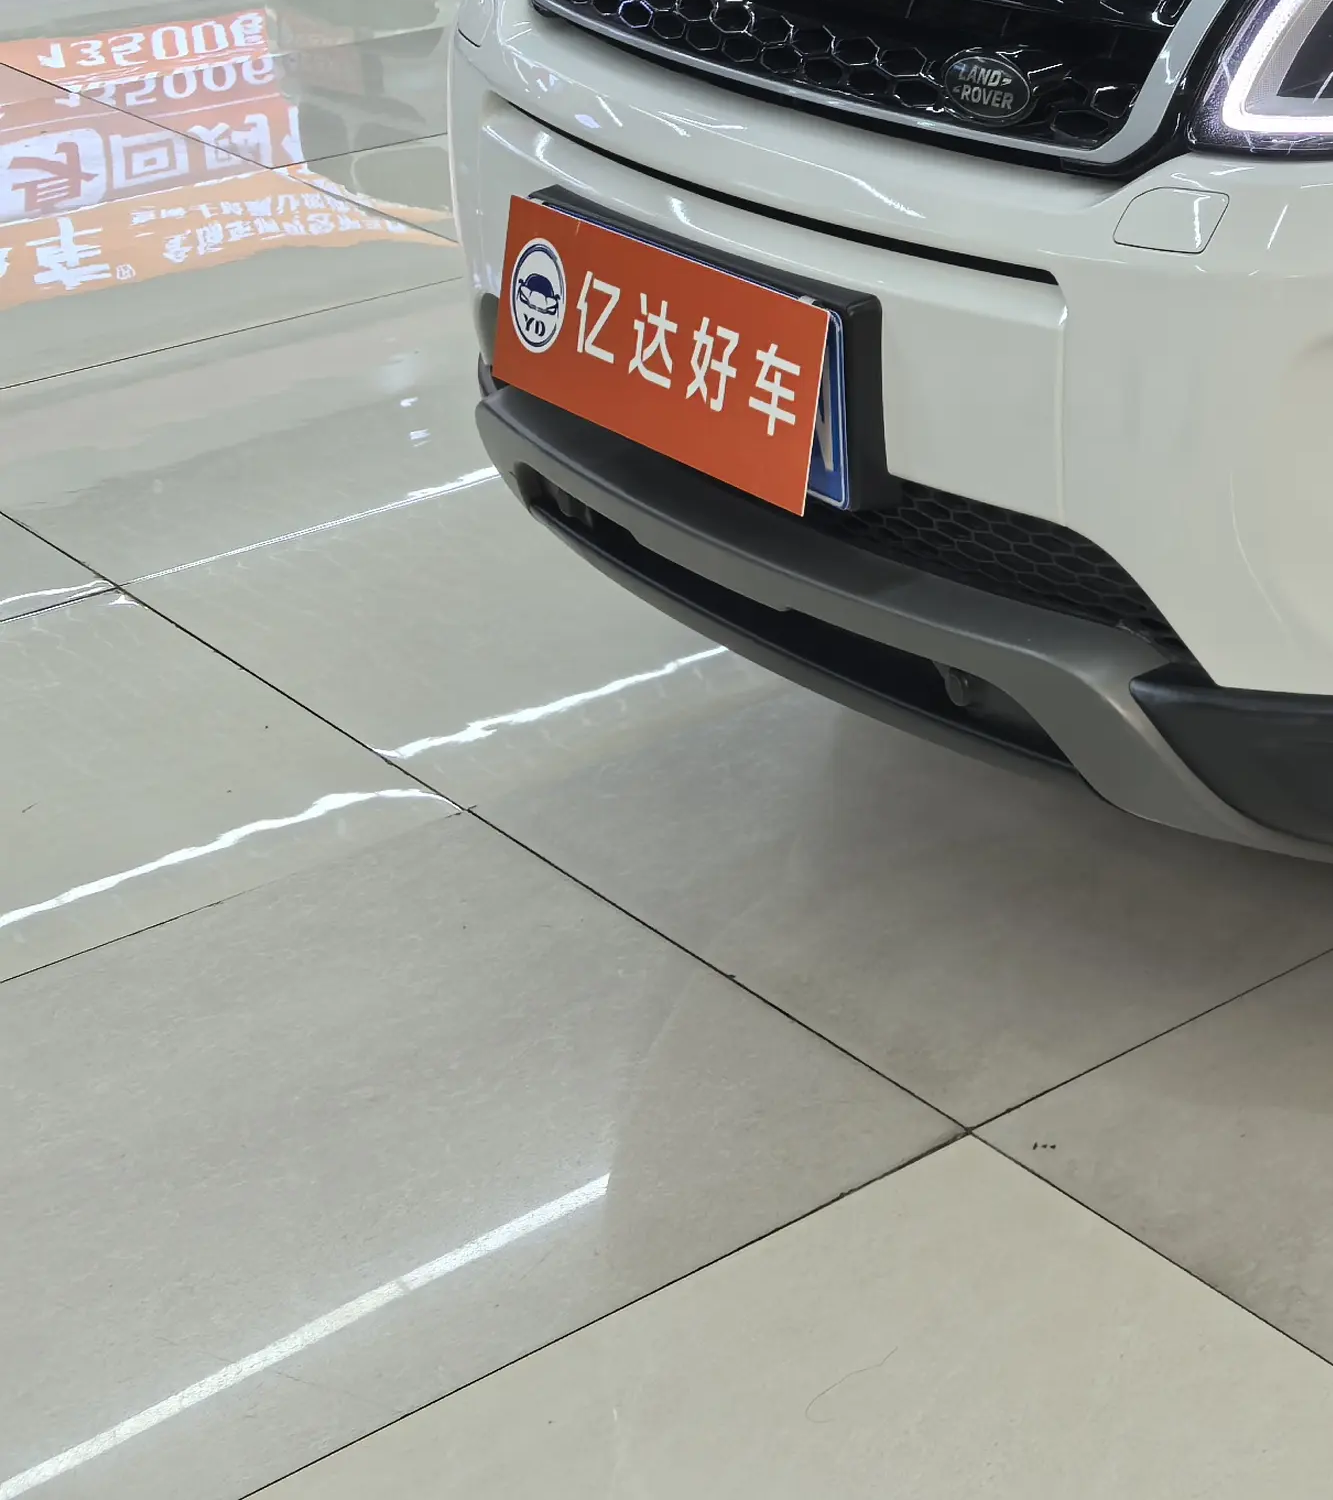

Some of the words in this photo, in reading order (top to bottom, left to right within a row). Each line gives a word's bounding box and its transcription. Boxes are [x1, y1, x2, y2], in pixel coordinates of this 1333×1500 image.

[958, 64, 1002, 87] LAND
[960, 84, 1014, 110] ROVER
[523, 312, 547, 339] YD
[577, 270, 801, 437] 亿达好车
